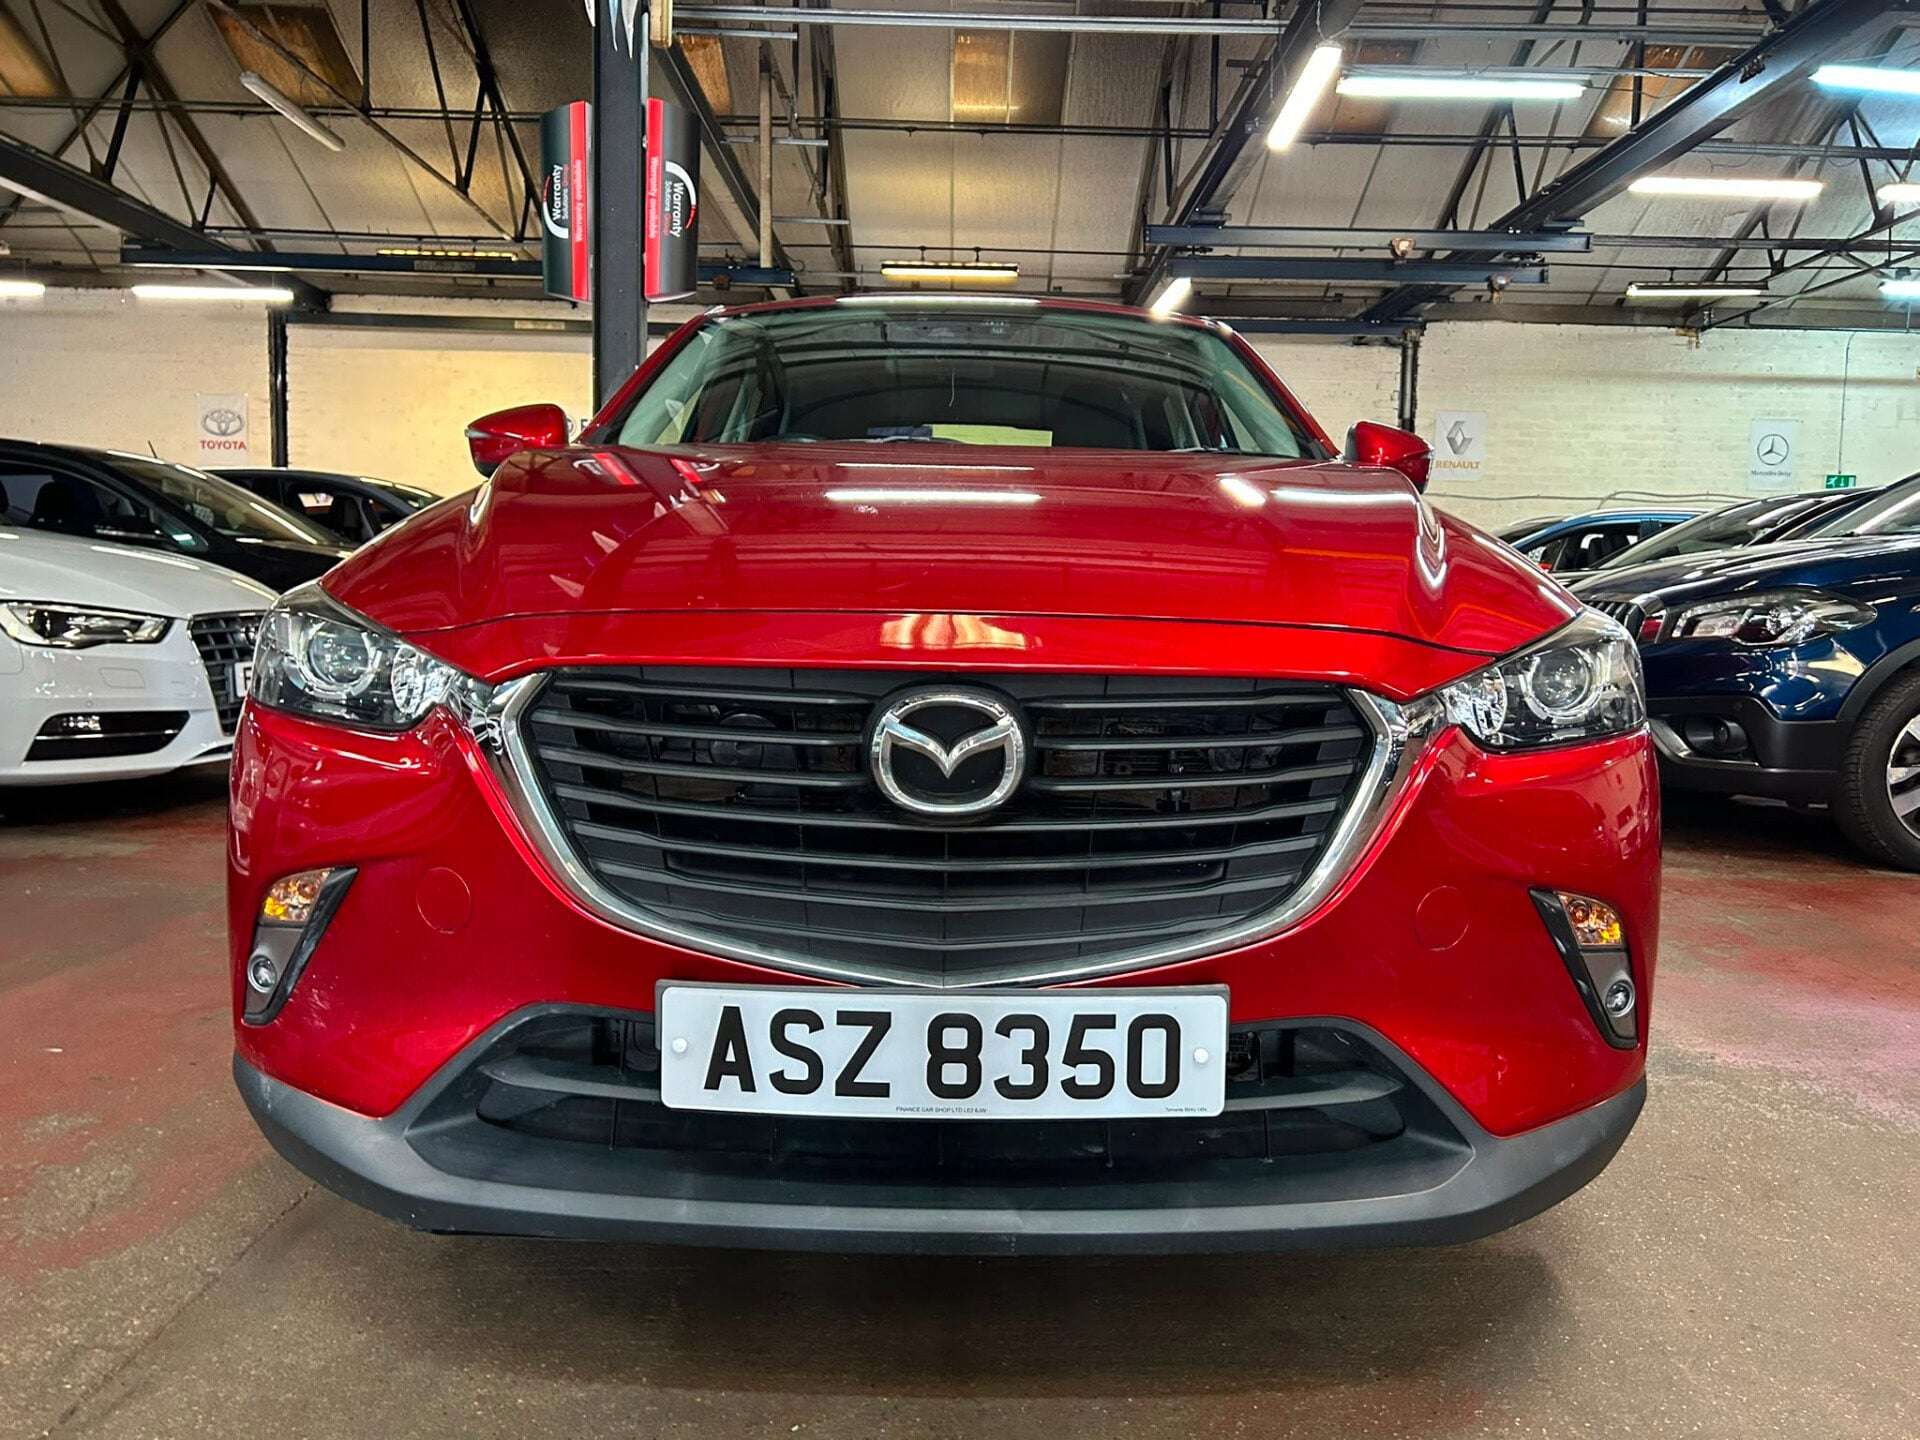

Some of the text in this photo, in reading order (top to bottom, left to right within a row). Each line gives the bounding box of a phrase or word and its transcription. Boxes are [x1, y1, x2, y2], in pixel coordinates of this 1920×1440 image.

[552, 164, 563, 221] Warranty
[648, 156, 659, 196] Warranty
[664, 180, 672, 212] Solutions
[575, 202, 584, 242] Warranty
[670, 182, 684, 238] Warranty
[200, 440, 247, 450] TOYOTA
[1435, 460, 1480, 469] RENAULT
[703, 1005, 1181, 1100] ASZ 8350
